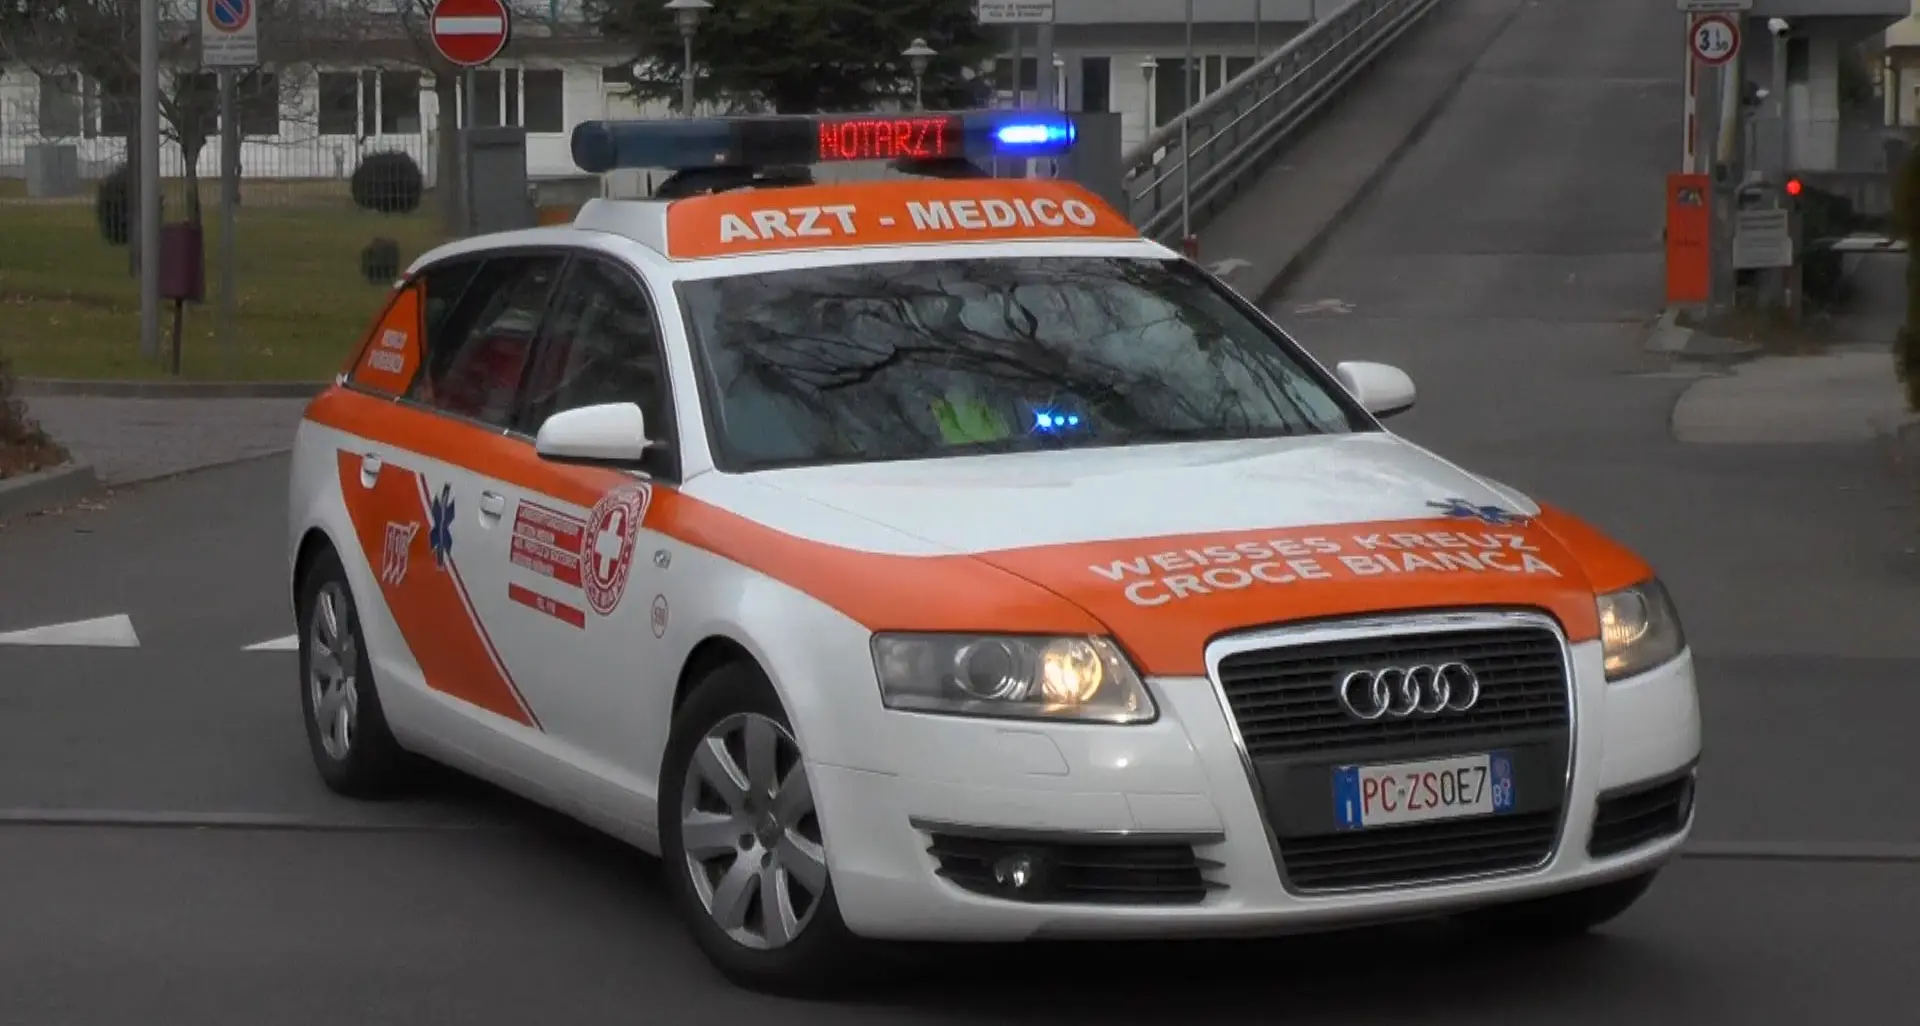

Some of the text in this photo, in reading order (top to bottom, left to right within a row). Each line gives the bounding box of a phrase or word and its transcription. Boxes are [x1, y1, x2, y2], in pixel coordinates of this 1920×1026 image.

[818, 118, 948, 160] NOTARZT
[719, 203, 857, 243] ARZT
[905, 199, 1097, 231] MEDICO
[1088, 531, 1541, 582] WEISSES KREUZ
[1123, 551, 1564, 608] CROCE BIANCA
